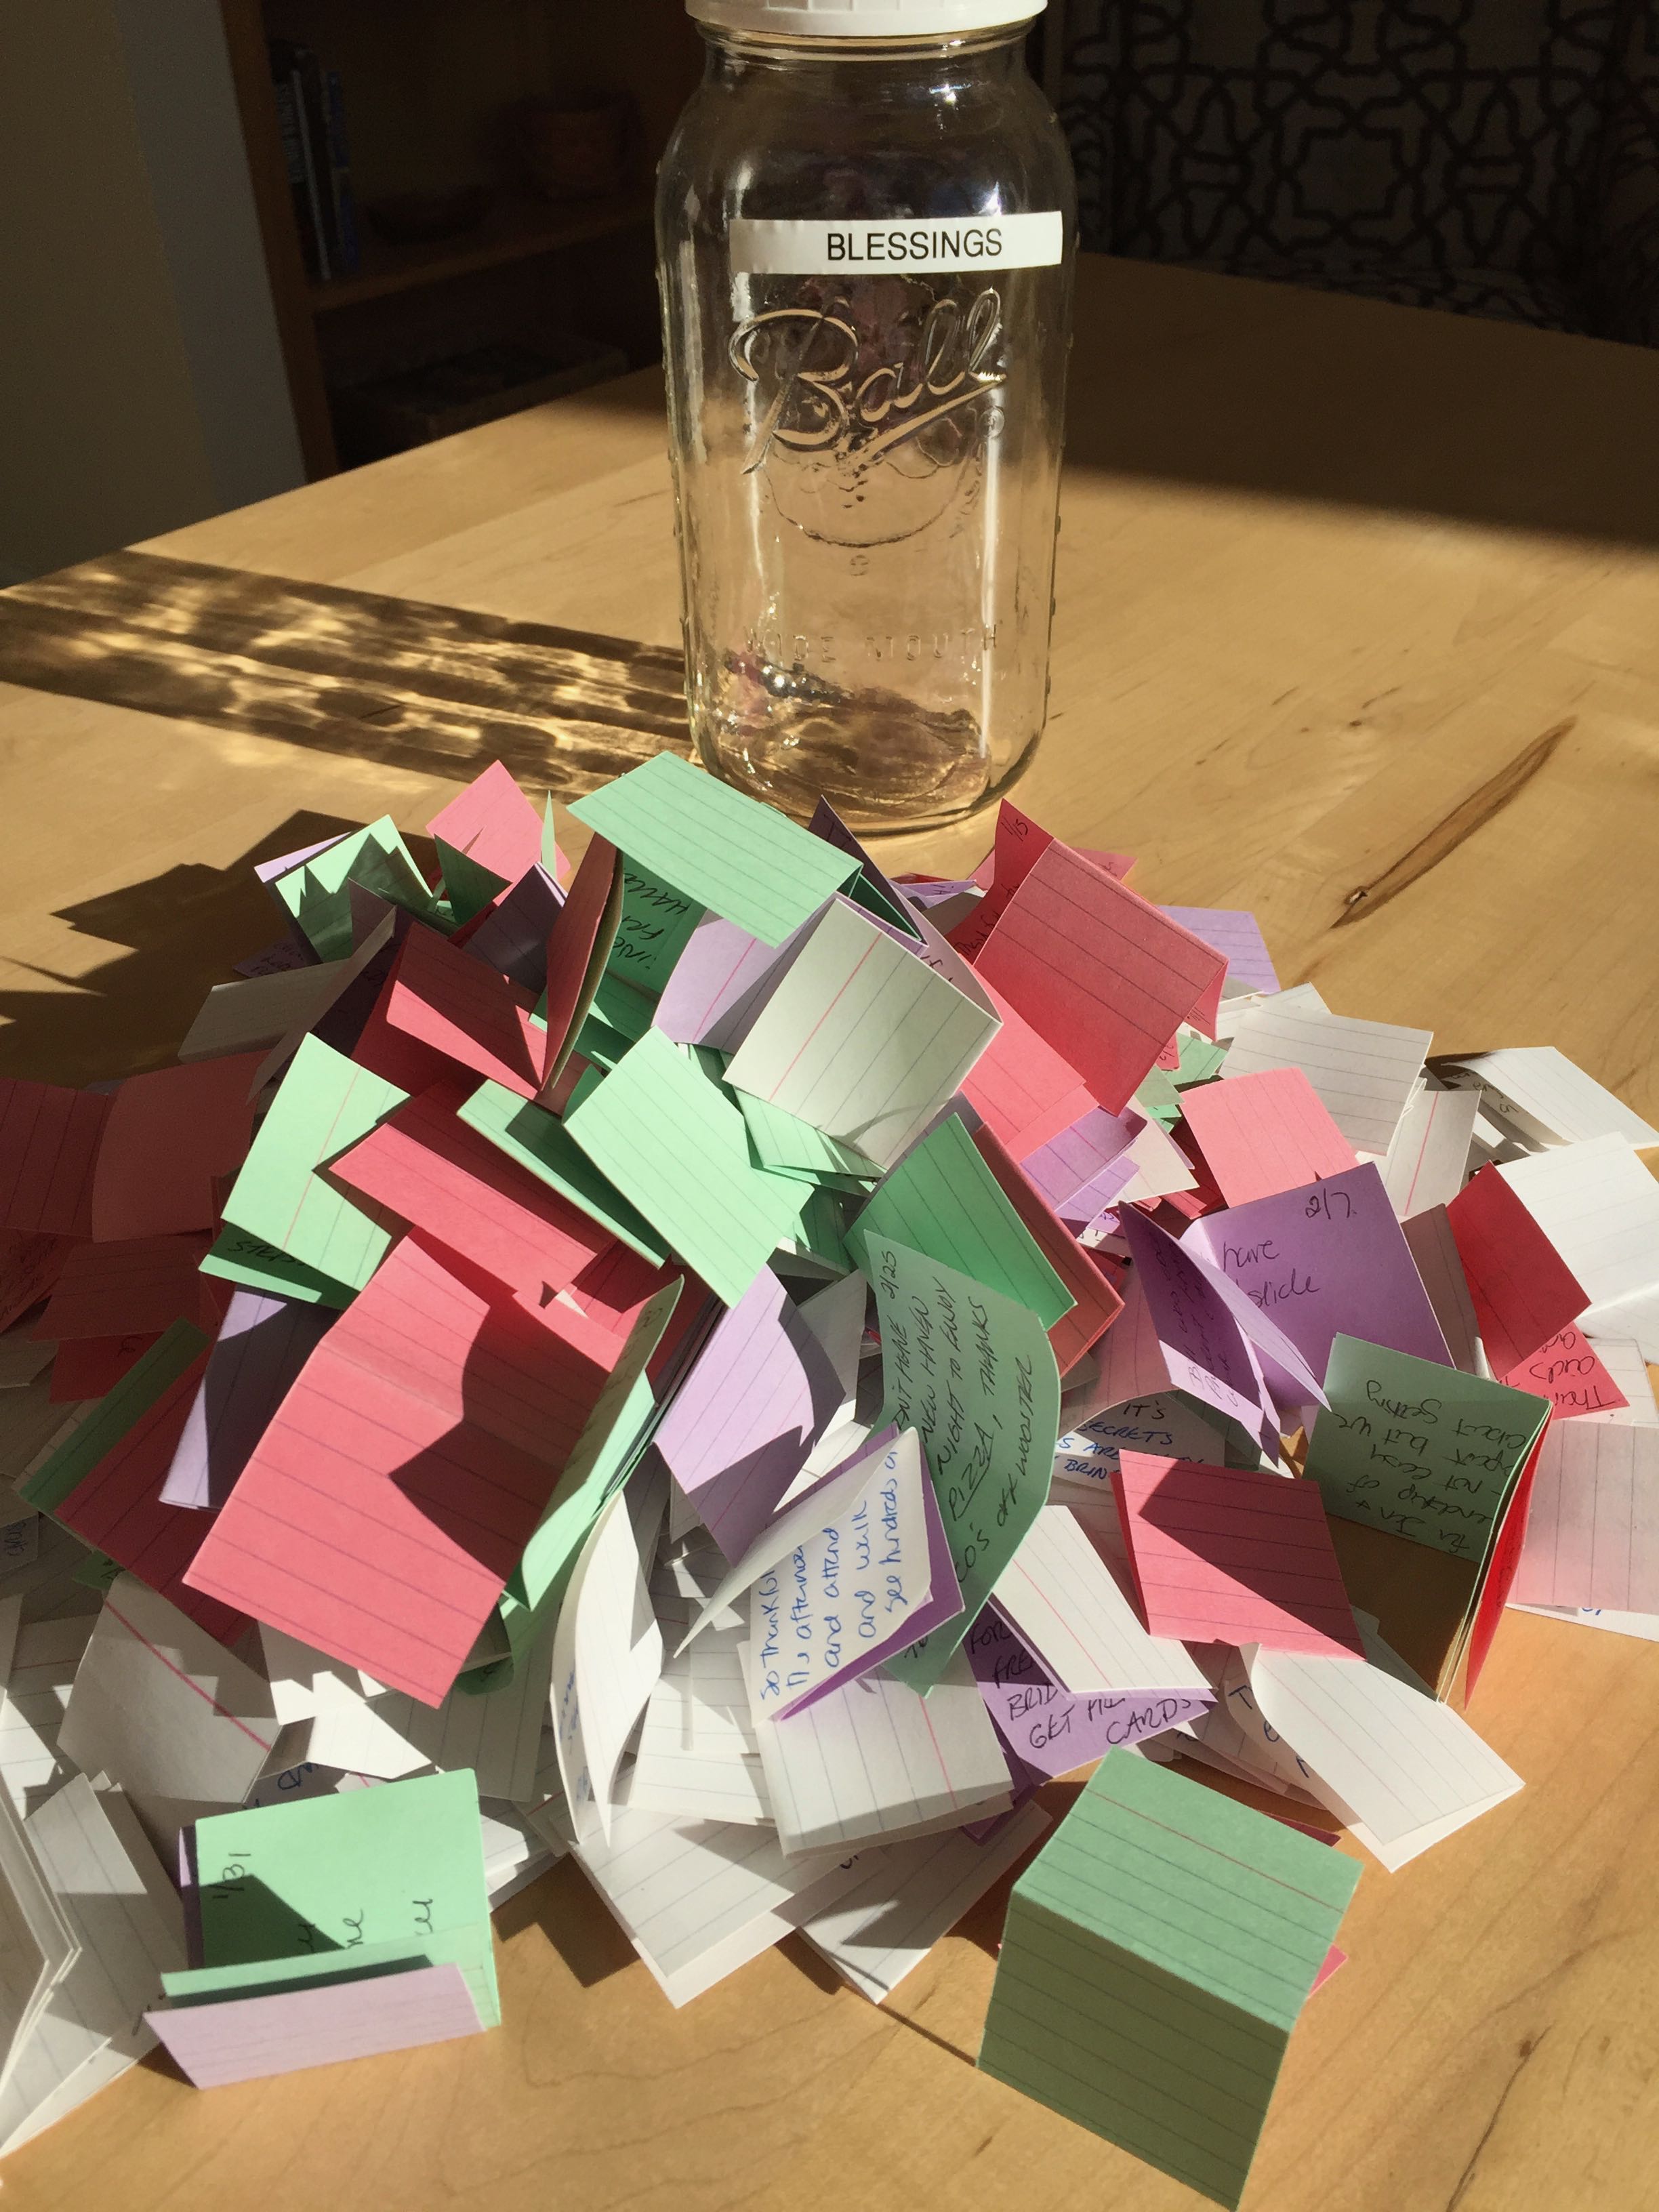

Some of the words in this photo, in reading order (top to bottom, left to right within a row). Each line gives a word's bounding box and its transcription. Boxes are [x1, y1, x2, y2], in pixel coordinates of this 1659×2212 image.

[827, 228, 1003, 262] BLESSINGS
[728, 287, 1008, 475] Ball
[879, 1250, 900, 1300] 2/25
[1223, 1240, 1280, 1273] have
[908, 1295, 937, 1377] HAVEN
[932, 1275, 962, 1353] ENJOY
[949, 1357, 963, 1380] TO
[968, 1296, 999, 1396] THANKS
[921, 1384, 937, 1443] NEW
[936, 1379, 966, 1475] NIGHT
[878, 1478, 901, 1565] hundreds
[821, 1527, 841, 1599] attend
[854, 1590, 877, 1639] and
[884, 1574, 908, 1613] see
[823, 1614, 842, 1668] and
[1029, 1704, 1076, 1748] GET
